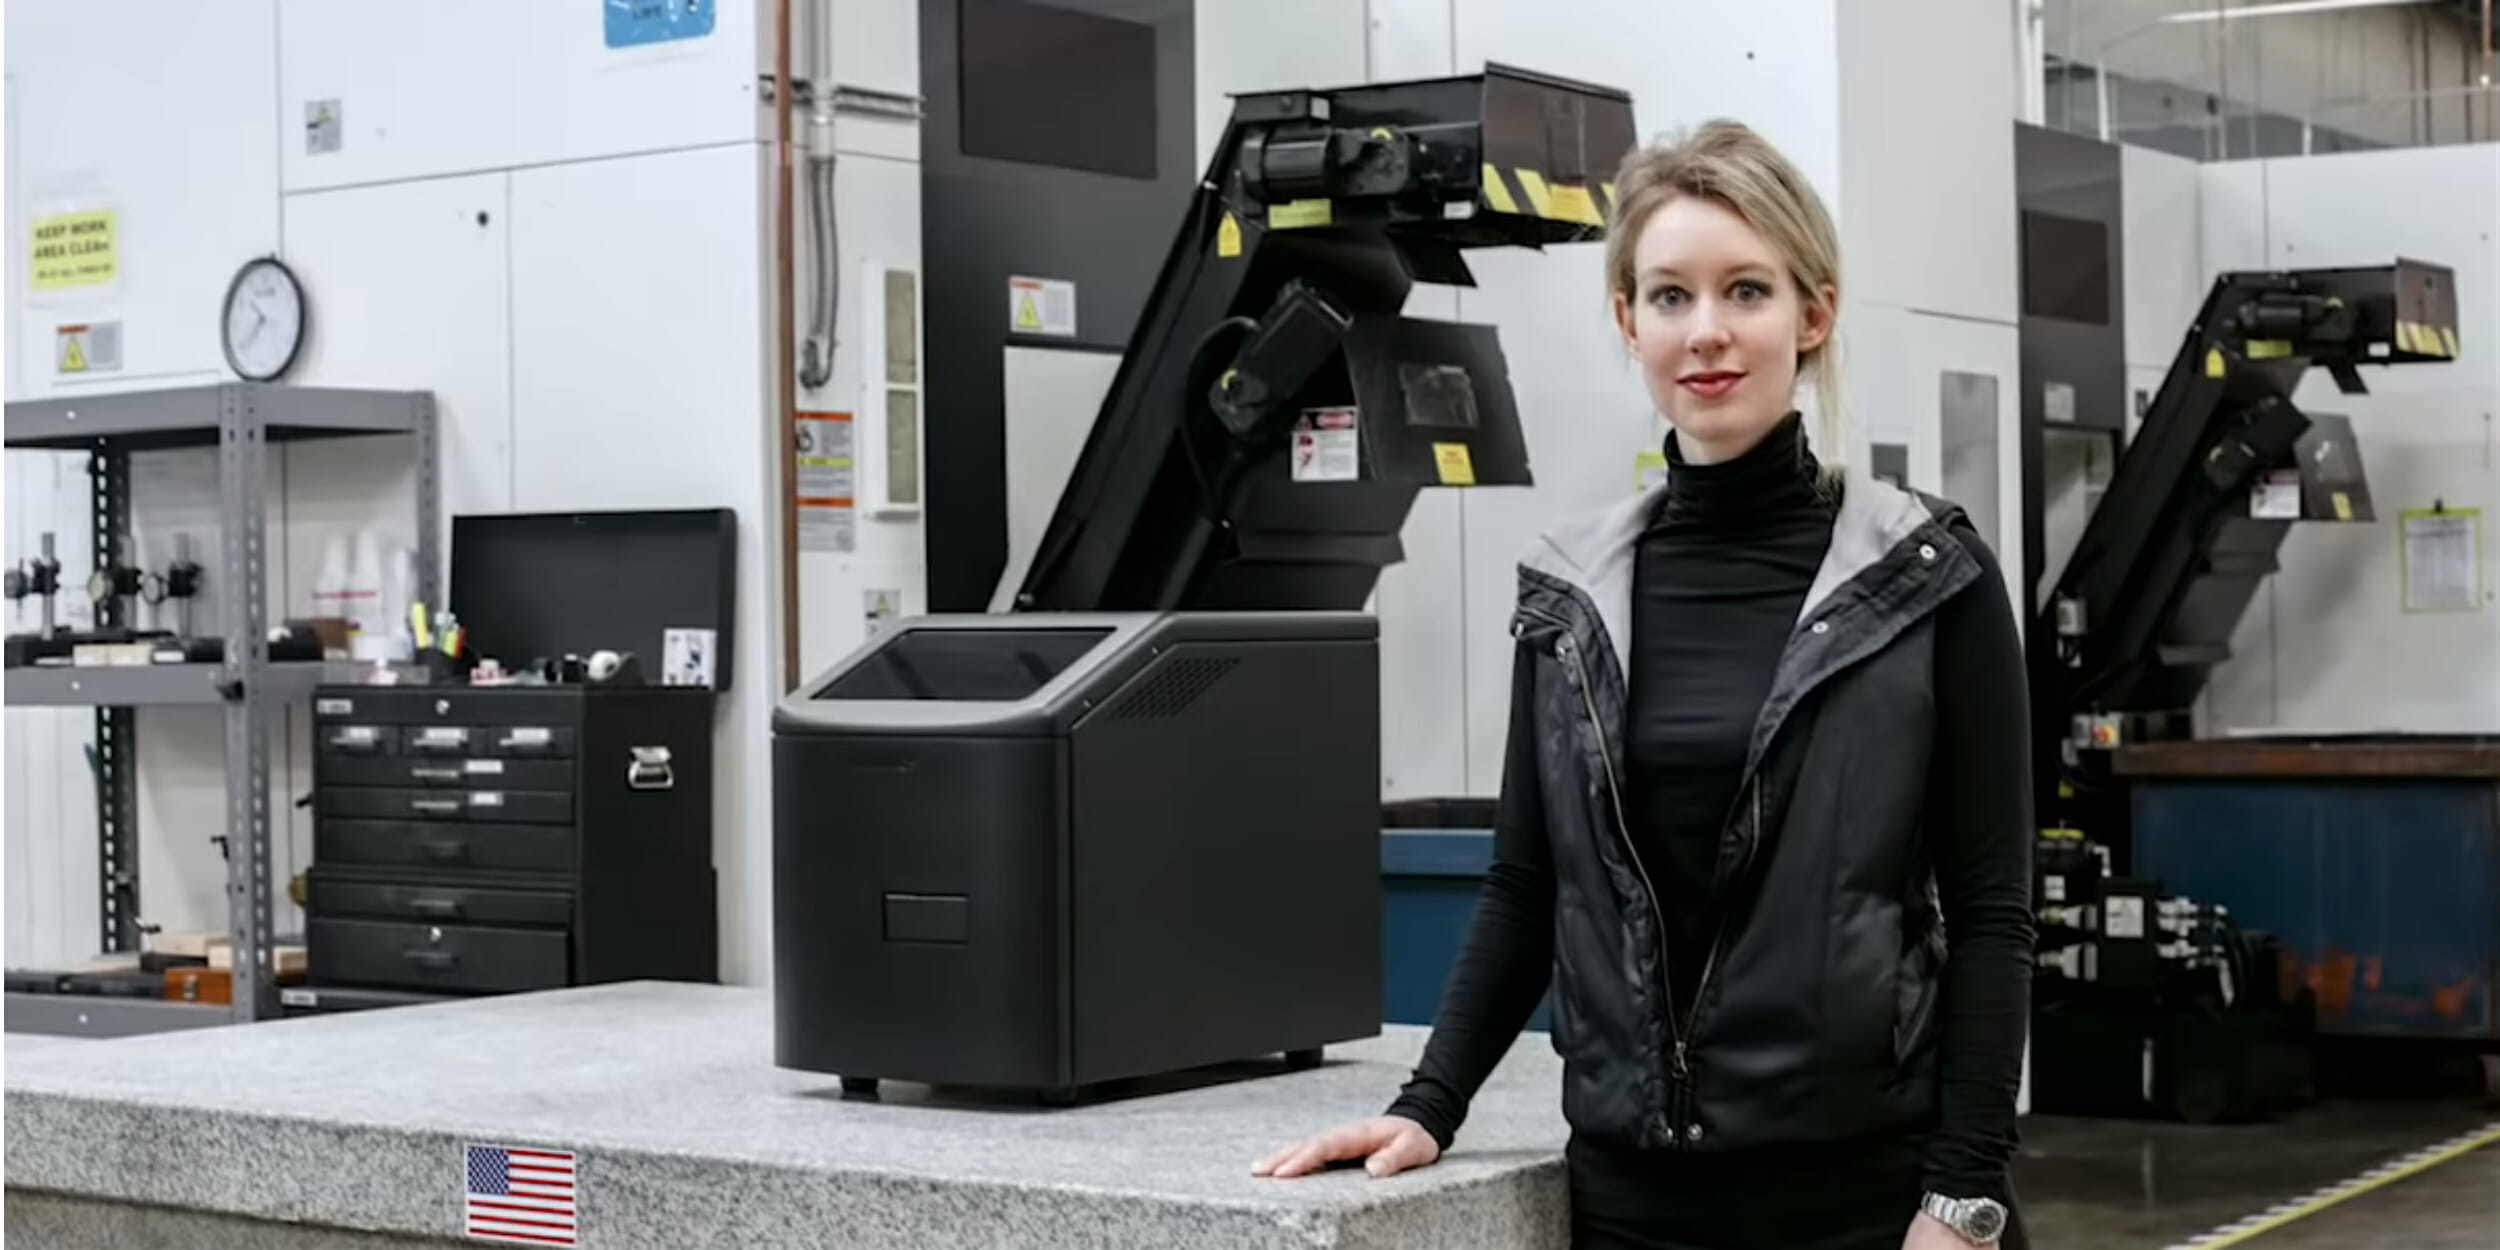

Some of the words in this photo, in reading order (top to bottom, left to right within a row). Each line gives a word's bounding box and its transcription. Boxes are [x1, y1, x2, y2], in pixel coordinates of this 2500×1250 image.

[35, 224, 66, 239] KEEP
[71, 220, 107, 235] WORK
[34, 245, 65, 259] AREA
